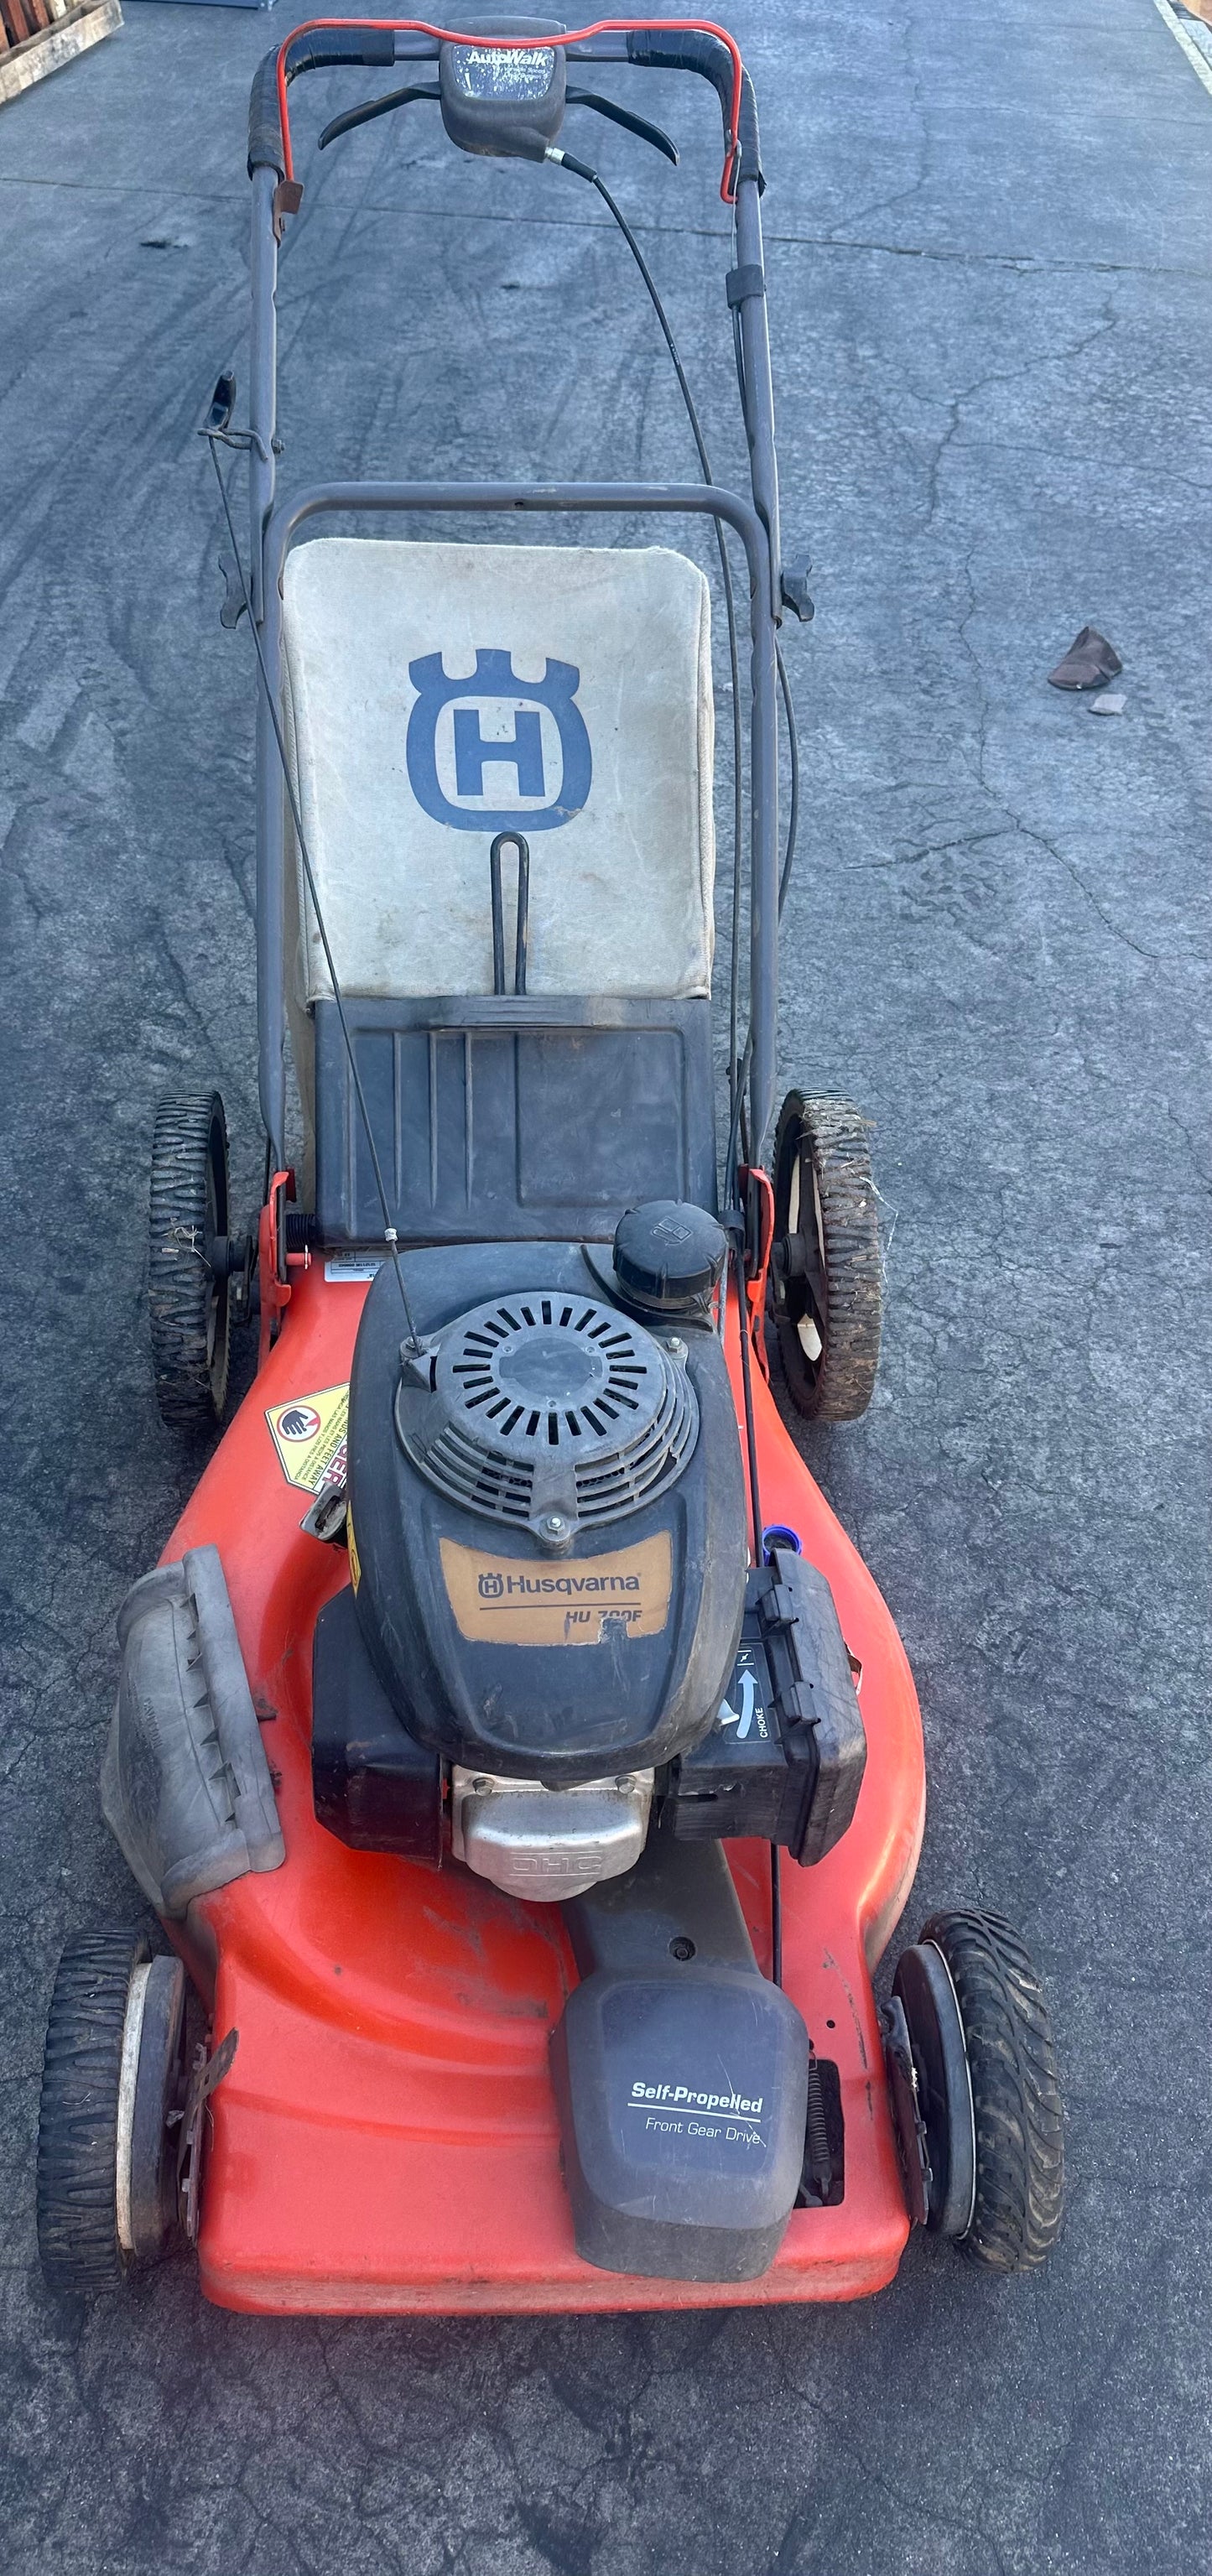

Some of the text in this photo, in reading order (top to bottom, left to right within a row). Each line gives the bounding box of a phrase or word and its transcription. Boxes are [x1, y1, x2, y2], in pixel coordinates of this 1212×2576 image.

[469, 50, 548, 66] AutoWalk
[453, 709, 545, 797] H
[329, 1433, 343, 1449] AND
[320, 1447, 334, 1465] FEET
[307, 1464, 324, 1486] AWAY
[507, 1575, 639, 1595] Husqvarna
[565, 1611, 590, 1623] HU
[755, 1707, 768, 1738] CHOKE
[512, 1856, 602, 1873] OHC
[632, 2082, 763, 2113] Self-Propelled
[645, 2117, 760, 2145] Front Gear Drive
